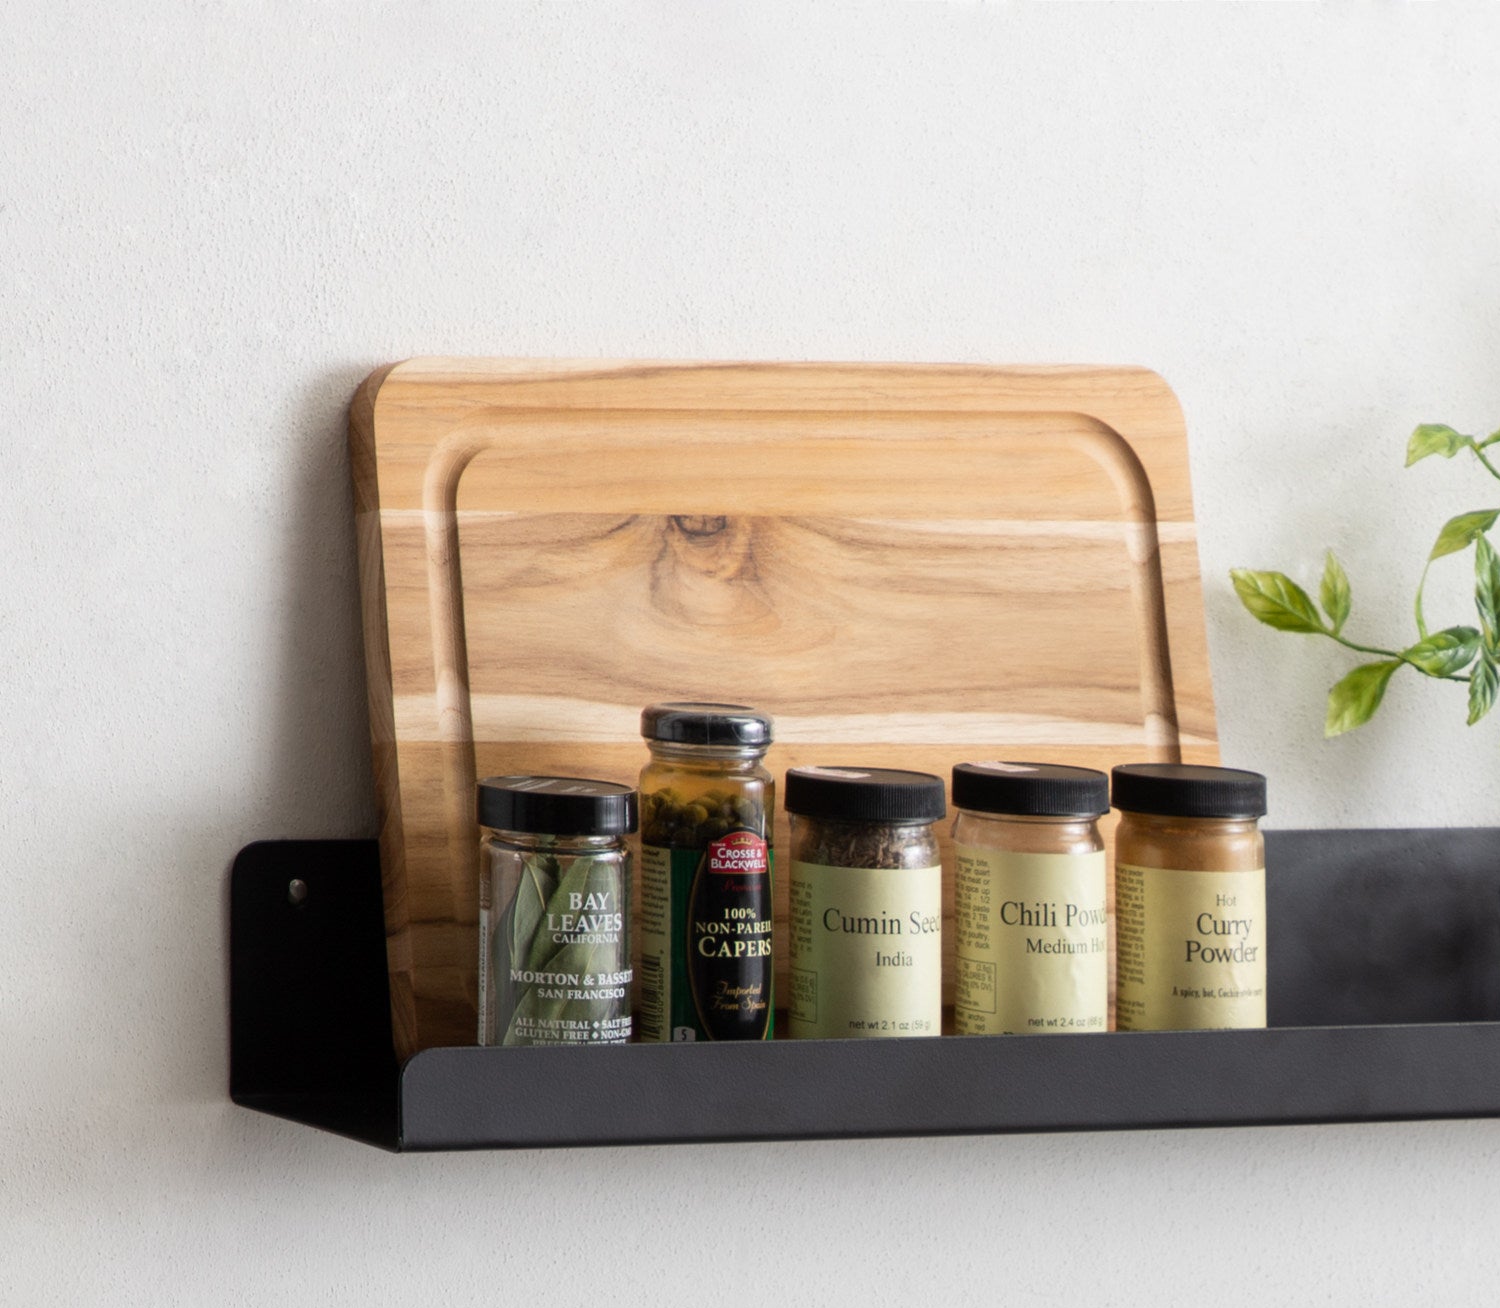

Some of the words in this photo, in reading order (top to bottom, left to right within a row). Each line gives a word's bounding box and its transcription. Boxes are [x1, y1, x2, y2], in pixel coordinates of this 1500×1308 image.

[717, 847, 755, 860] CROSSE
[711, 858, 766, 871] BLACKWELL
[568, 891, 610, 911] BAY
[1216, 894, 1237, 907] Hot
[724, 907, 757, 920] 100%
[822, 907, 901, 935] Cumin
[1000, 901, 1057, 927] Chili
[547, 913, 623, 932] LEAVES
[695, 920, 772, 934] NON-PAREIL
[1196, 912, 1252, 941] Curry
[552, 933, 619, 945] CALIFORNIA
[1026, 937, 1088, 954] Medium
[698, 936, 772, 958] CAPERS
[1184, 939, 1258, 964] Powder
[876, 950, 913, 967] India
[510, 969, 580, 986] MORTON
[583, 975, 595, 986] &
[537, 988, 563, 999] SAN
[567, 987, 625, 1000] FRANCISCO
[717, 980, 762, 999] Imported
[1172, 986, 1179, 996] A
[1180, 987, 1200, 999] spicy,
[711, 995, 739, 1010] From
[741, 996, 766, 1013] Spain
[515, 1017, 536, 1027] ALL
[541, 1018, 591, 1030] NATURAL
[601, 1018, 621, 1030] SALT
[849, 1020, 865, 1030] net
[868, 1020, 879, 1030] wt
[900, 1022, 909, 1030] oz
[1028, 1018, 1044, 1027] net
[1046, 1018, 1058, 1027] wt
[1060, 1017, 1074, 1027] 2.4
[1076, 1019, 1085, 1027] oz
[515, 1027, 561, 1039] GLUTEN
[563, 1031, 590, 1041] FREE
